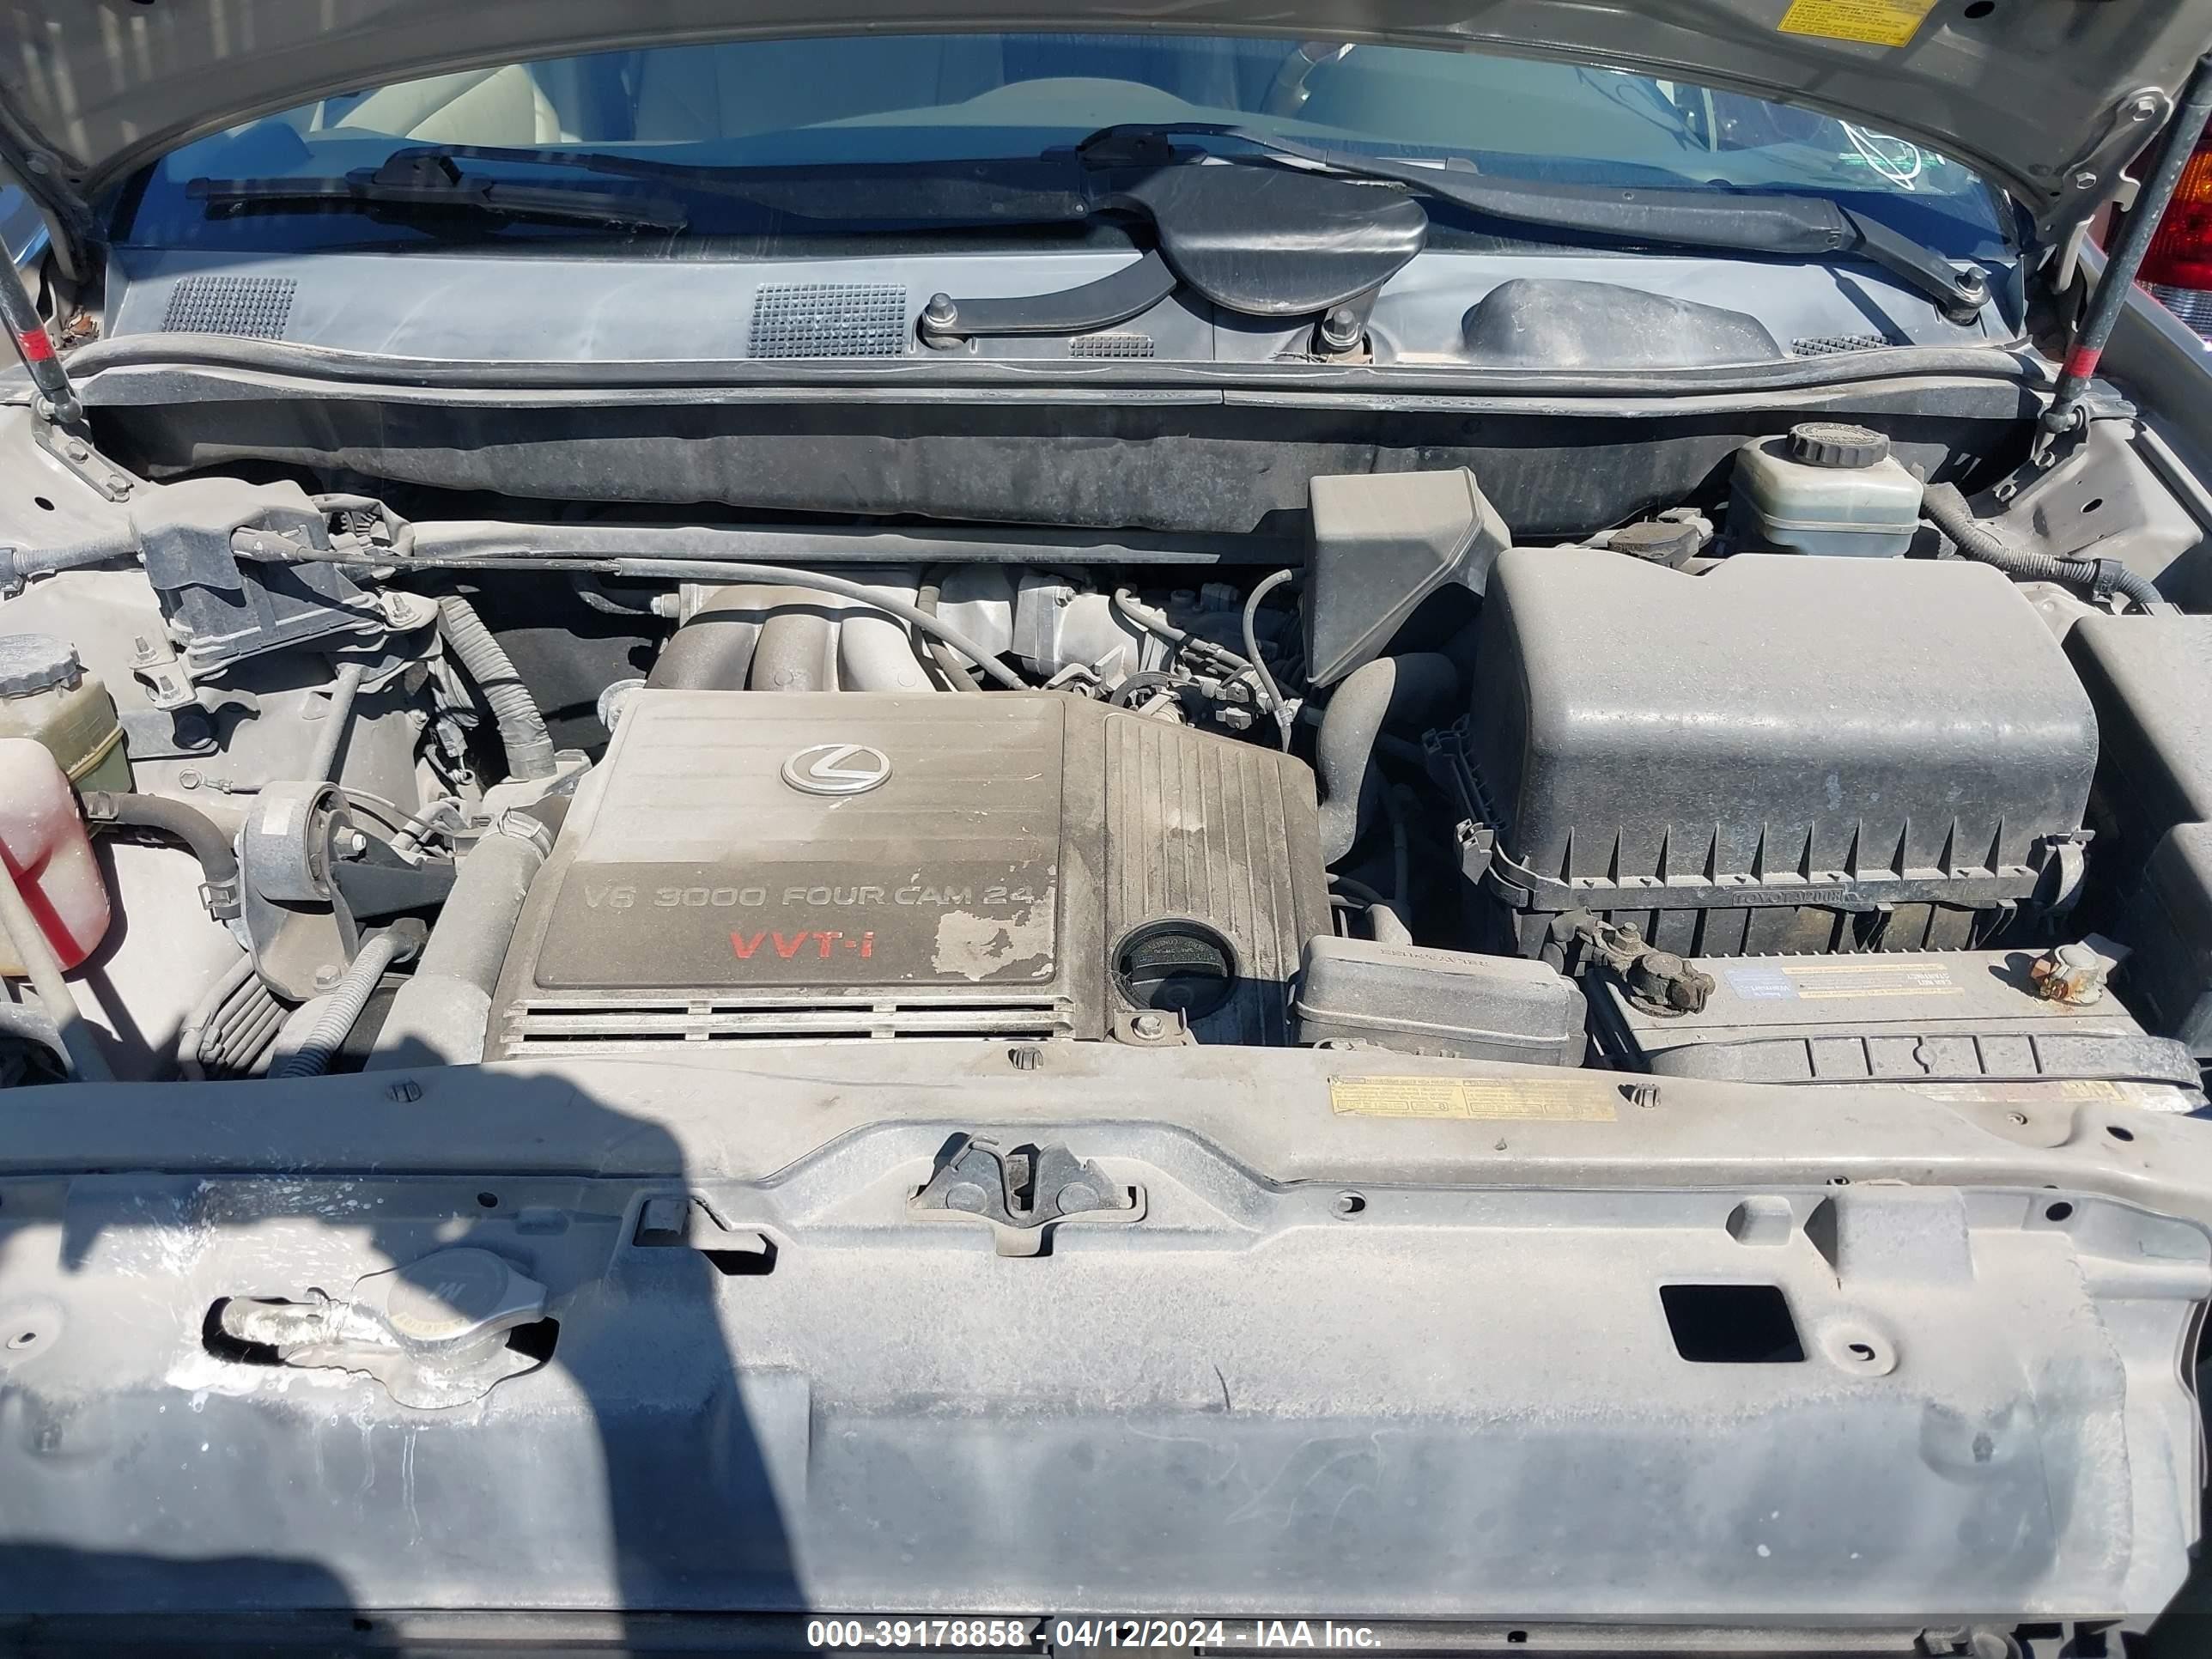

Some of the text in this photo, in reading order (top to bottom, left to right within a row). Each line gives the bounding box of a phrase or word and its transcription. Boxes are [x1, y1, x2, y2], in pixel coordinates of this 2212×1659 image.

[584, 886, 636, 908] V6
[653, 886, 768, 907] 3000
[781, 886, 887, 907] FOUR
[893, 885, 972, 906] CAM
[729, 929, 875, 959] VVT-i
